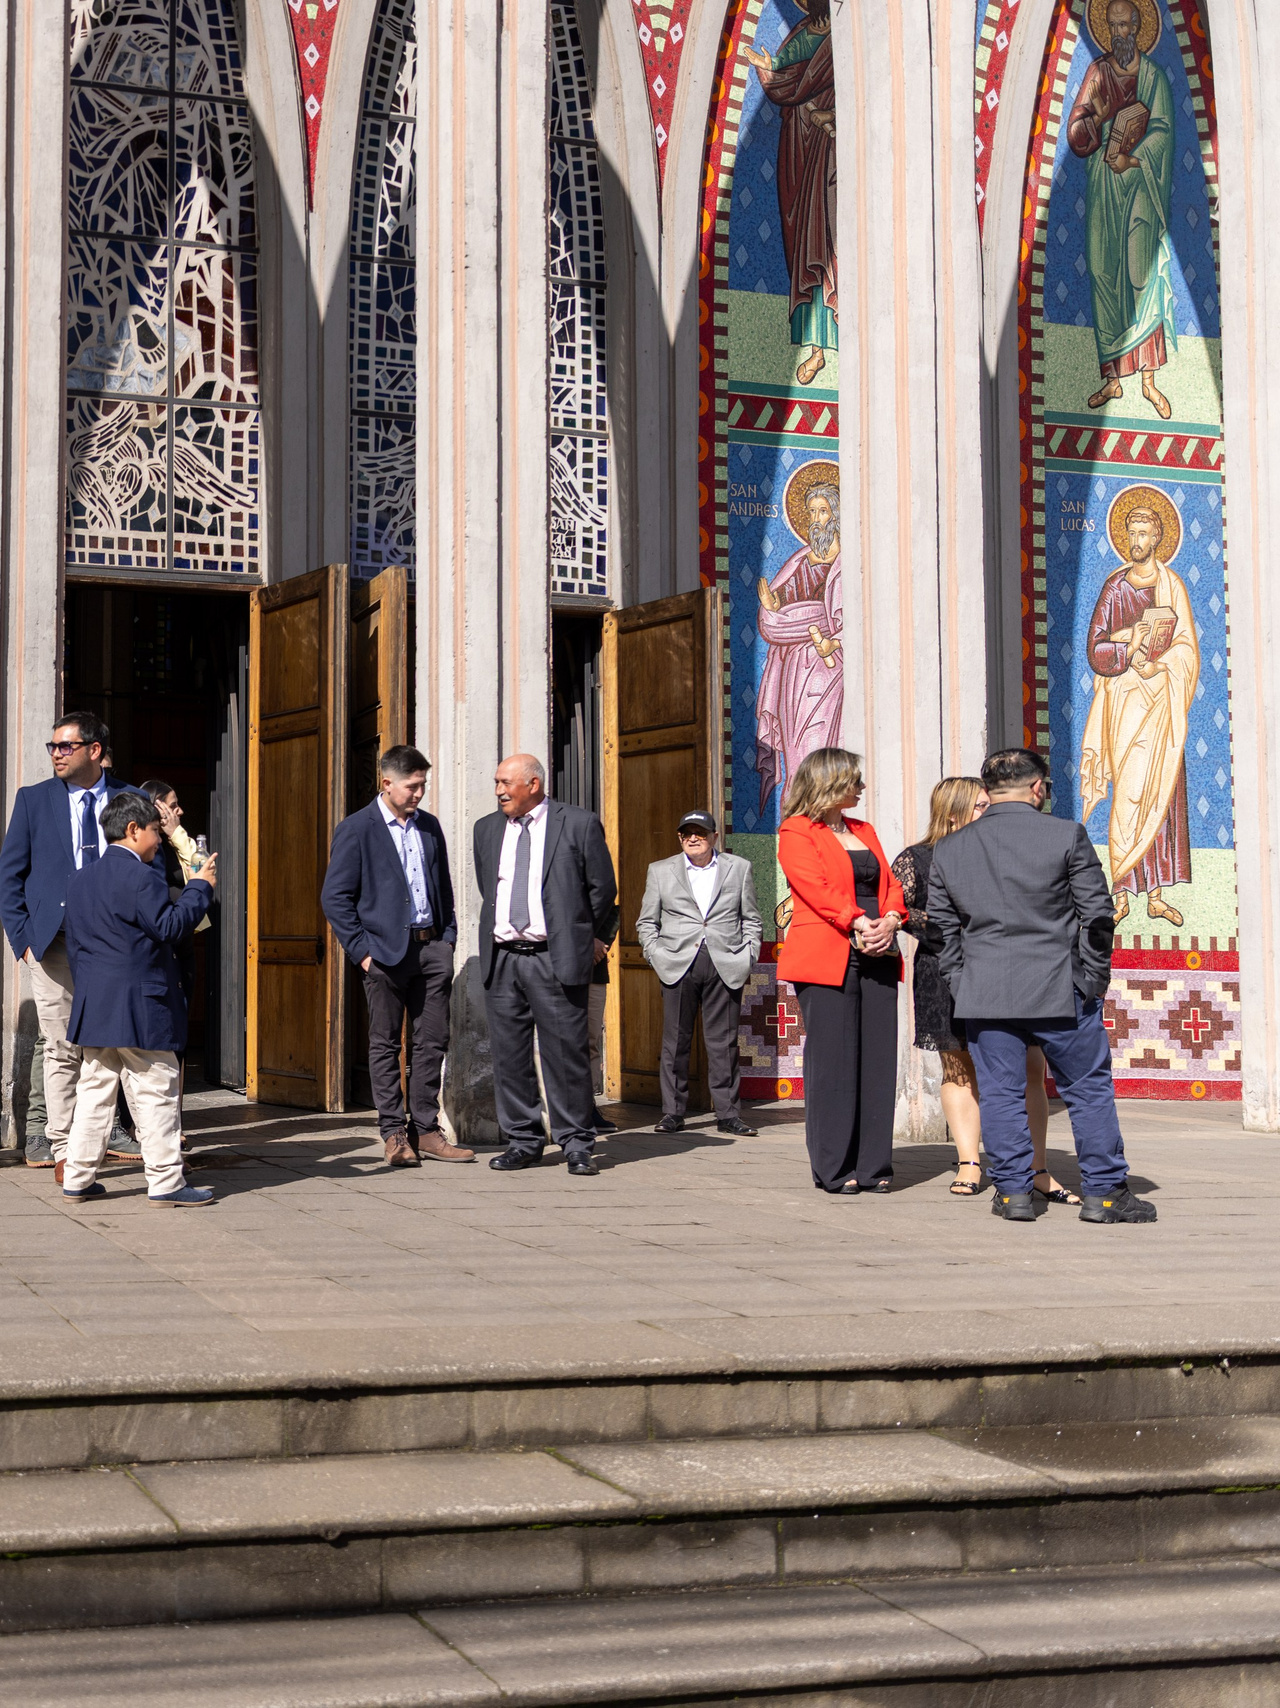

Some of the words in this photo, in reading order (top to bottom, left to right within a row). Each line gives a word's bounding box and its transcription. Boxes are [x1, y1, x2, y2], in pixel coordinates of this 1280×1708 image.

[730, 483, 757, 498] SAN
[728, 501, 779, 519] ANDRES
[1060, 500, 1086, 514] SAN
[1060, 518, 1096, 532] LUCAS
